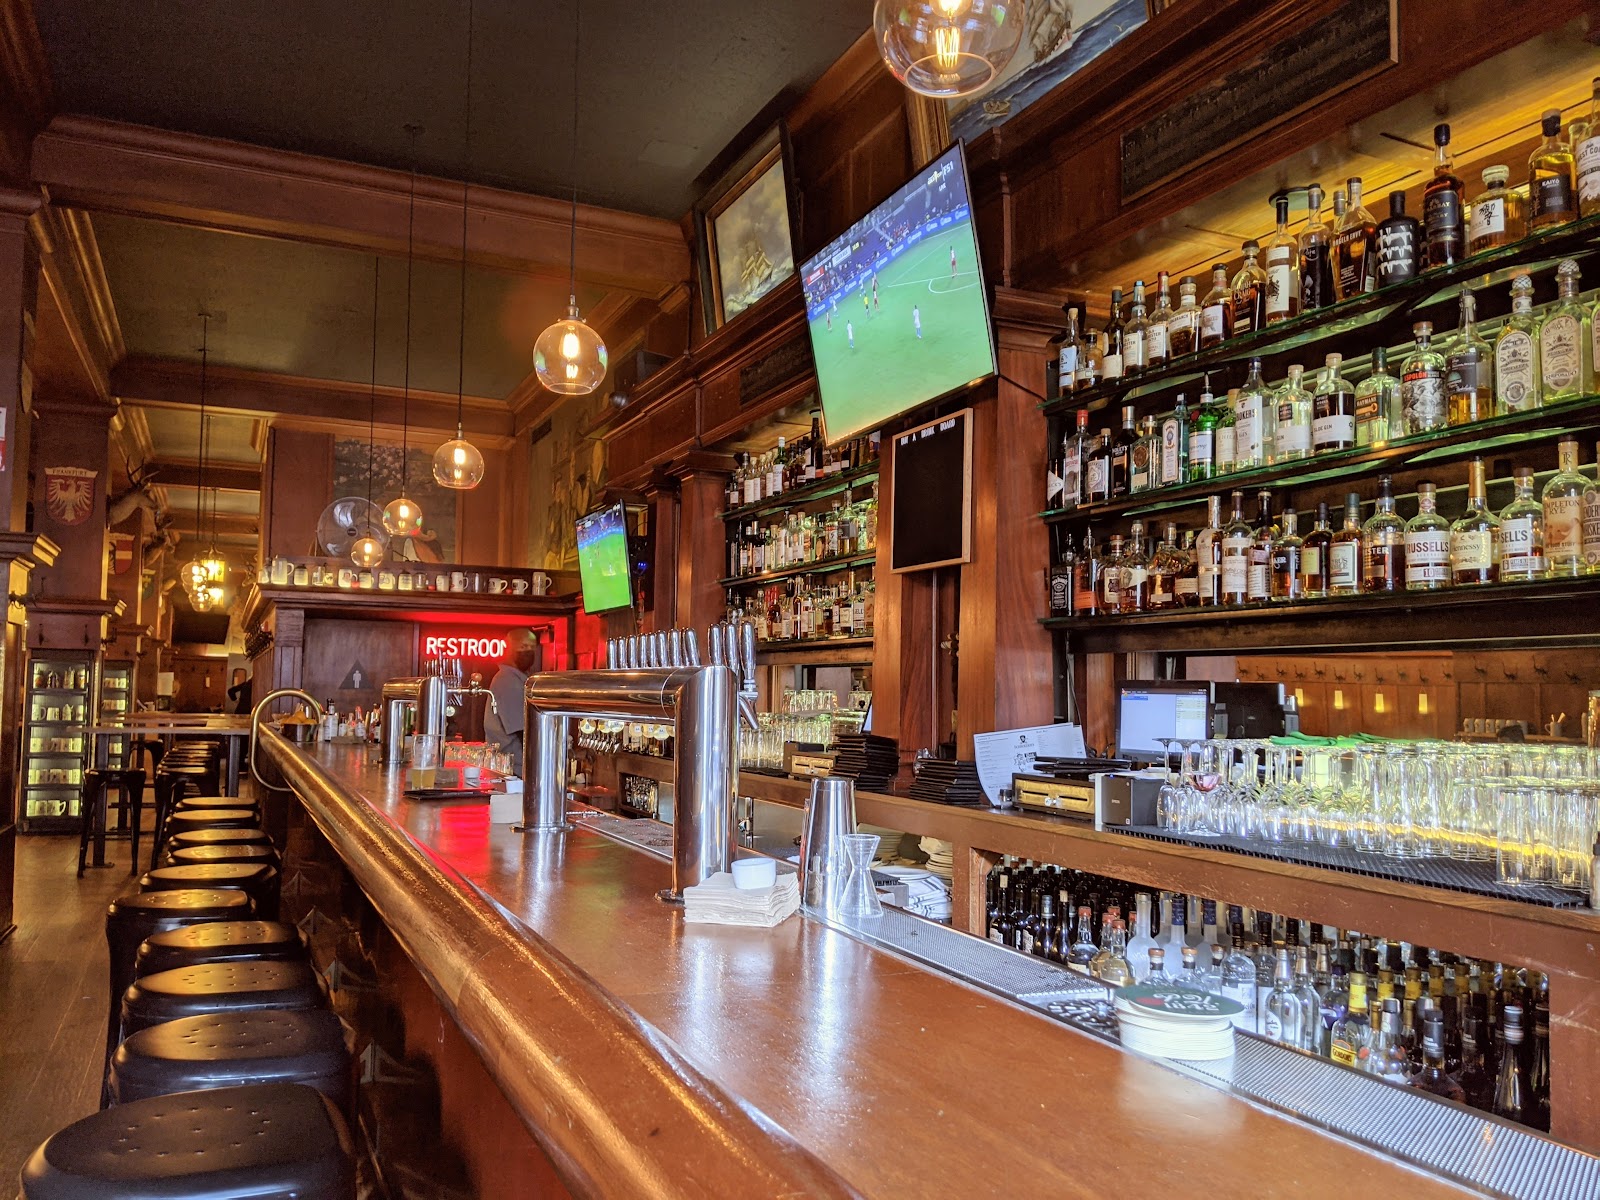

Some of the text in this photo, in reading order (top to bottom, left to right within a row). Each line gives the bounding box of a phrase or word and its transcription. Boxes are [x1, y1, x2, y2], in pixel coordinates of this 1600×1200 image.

[943, 160, 954, 175] FS1
[912, 432, 917, 442] A
[52, 468, 88, 476] FRANKFURT
[1549, 506, 1566, 515] RYE
[1500, 529, 1528, 544] SELL'S
[1406, 541, 1449, 554] RUSSELL'S
[1424, 568, 1435, 578] 10
